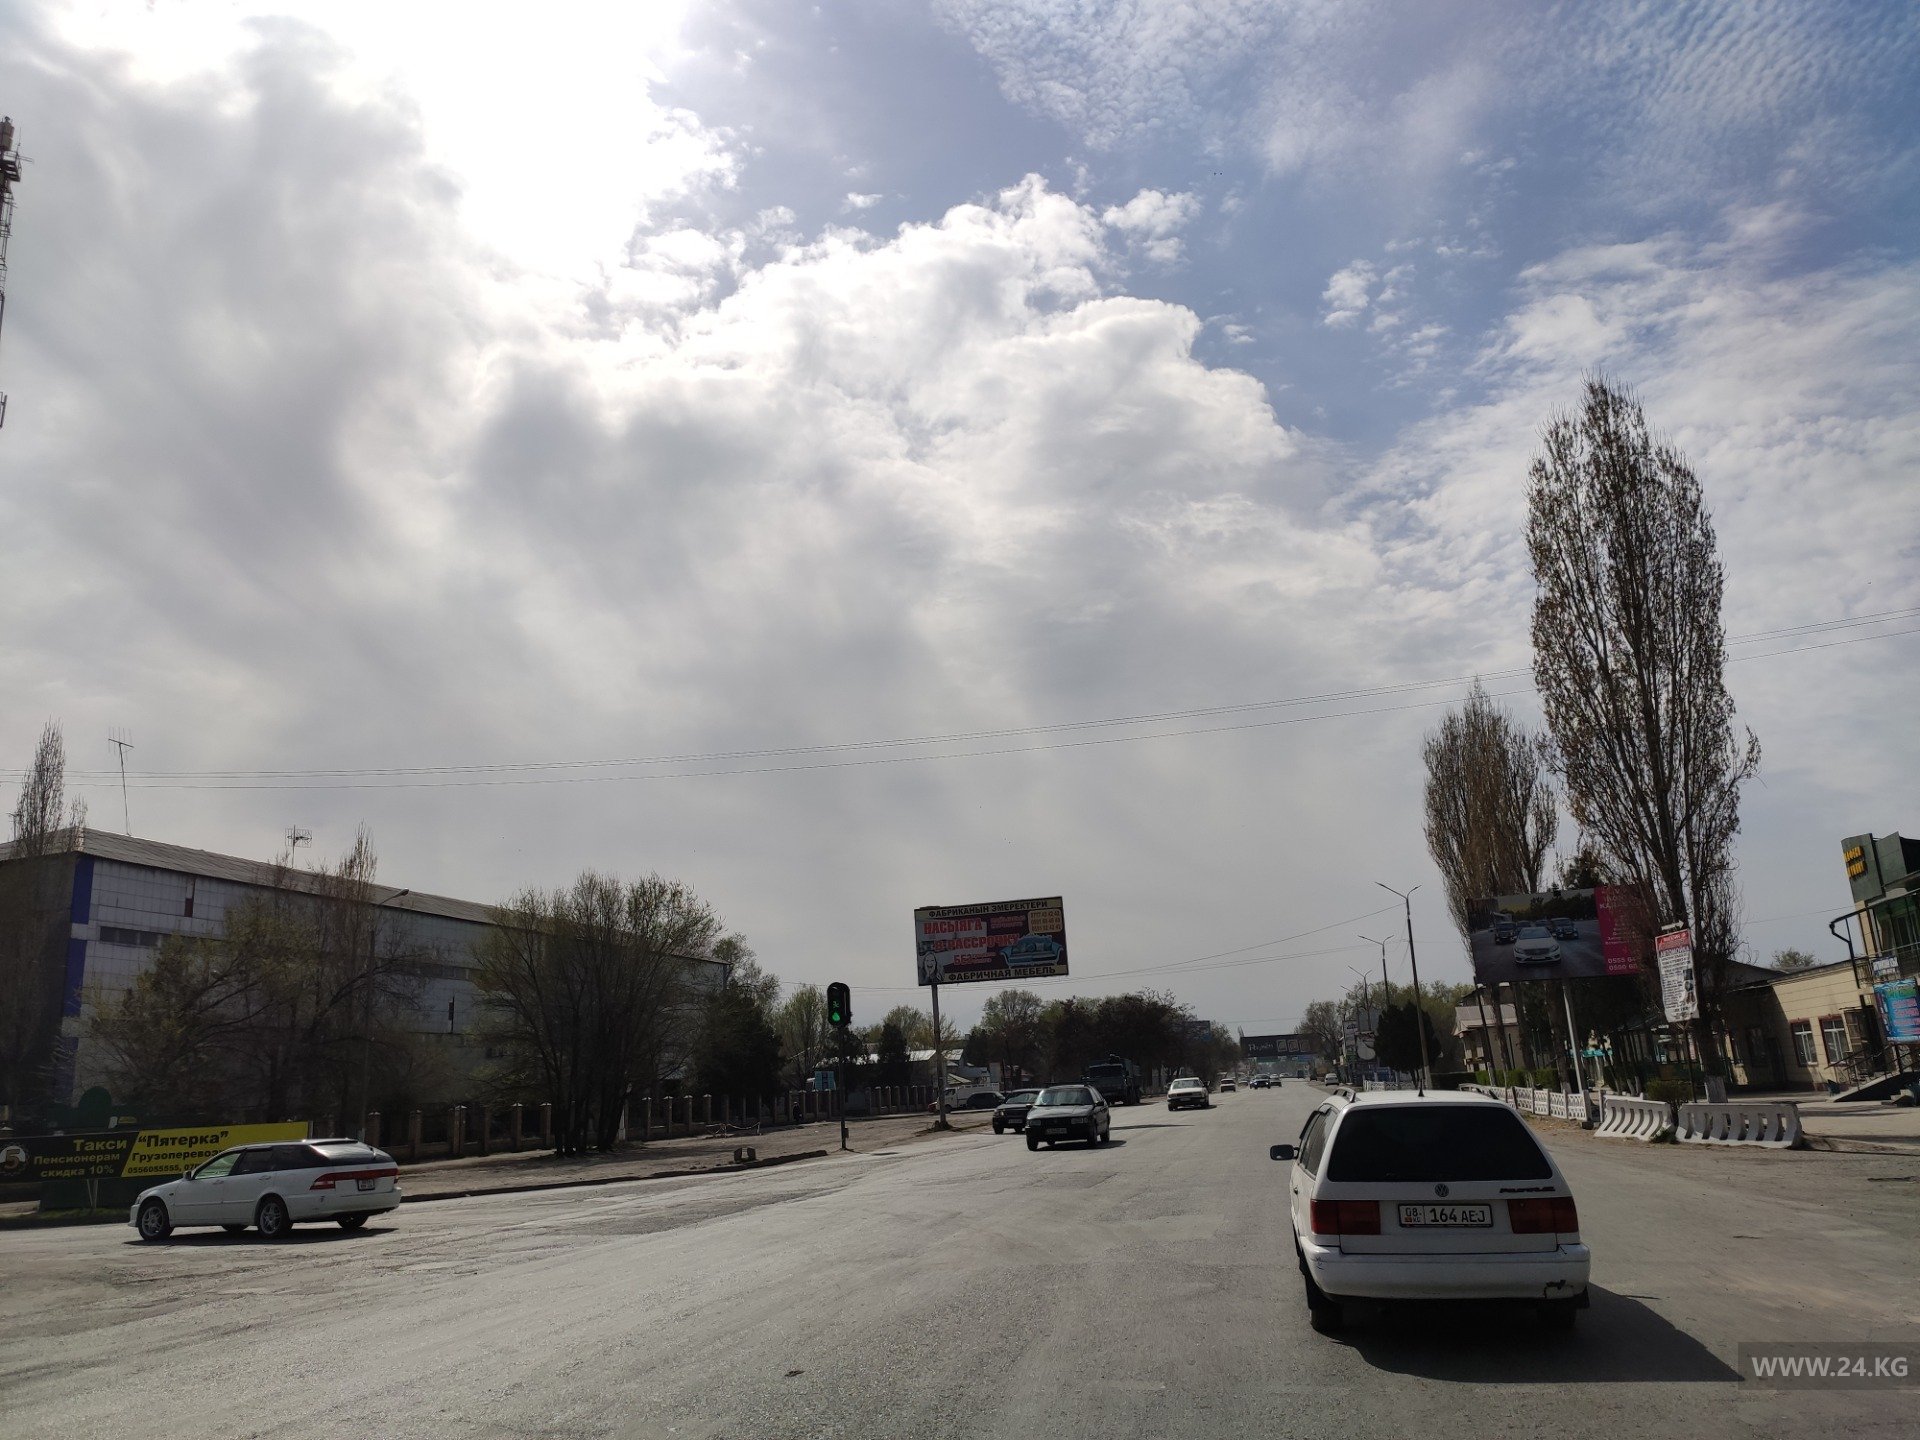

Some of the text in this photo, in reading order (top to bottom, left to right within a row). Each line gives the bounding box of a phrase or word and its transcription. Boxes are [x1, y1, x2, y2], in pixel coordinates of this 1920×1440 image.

[929, 900, 1048, 918] ФАБРИКАНЫН ЭМЕРЕКТЕРИ
[948, 966, 1056, 982] ФАБРИЧНАЯ МЕБЕЛЬ
[73, 1139, 128, 1152] Такси
[33, 1153, 120, 1165] Пенсионерам
[40, 1165, 115, 1178] скидка 10%
[1430, 1208, 1485, 1223] 164 AEJ
